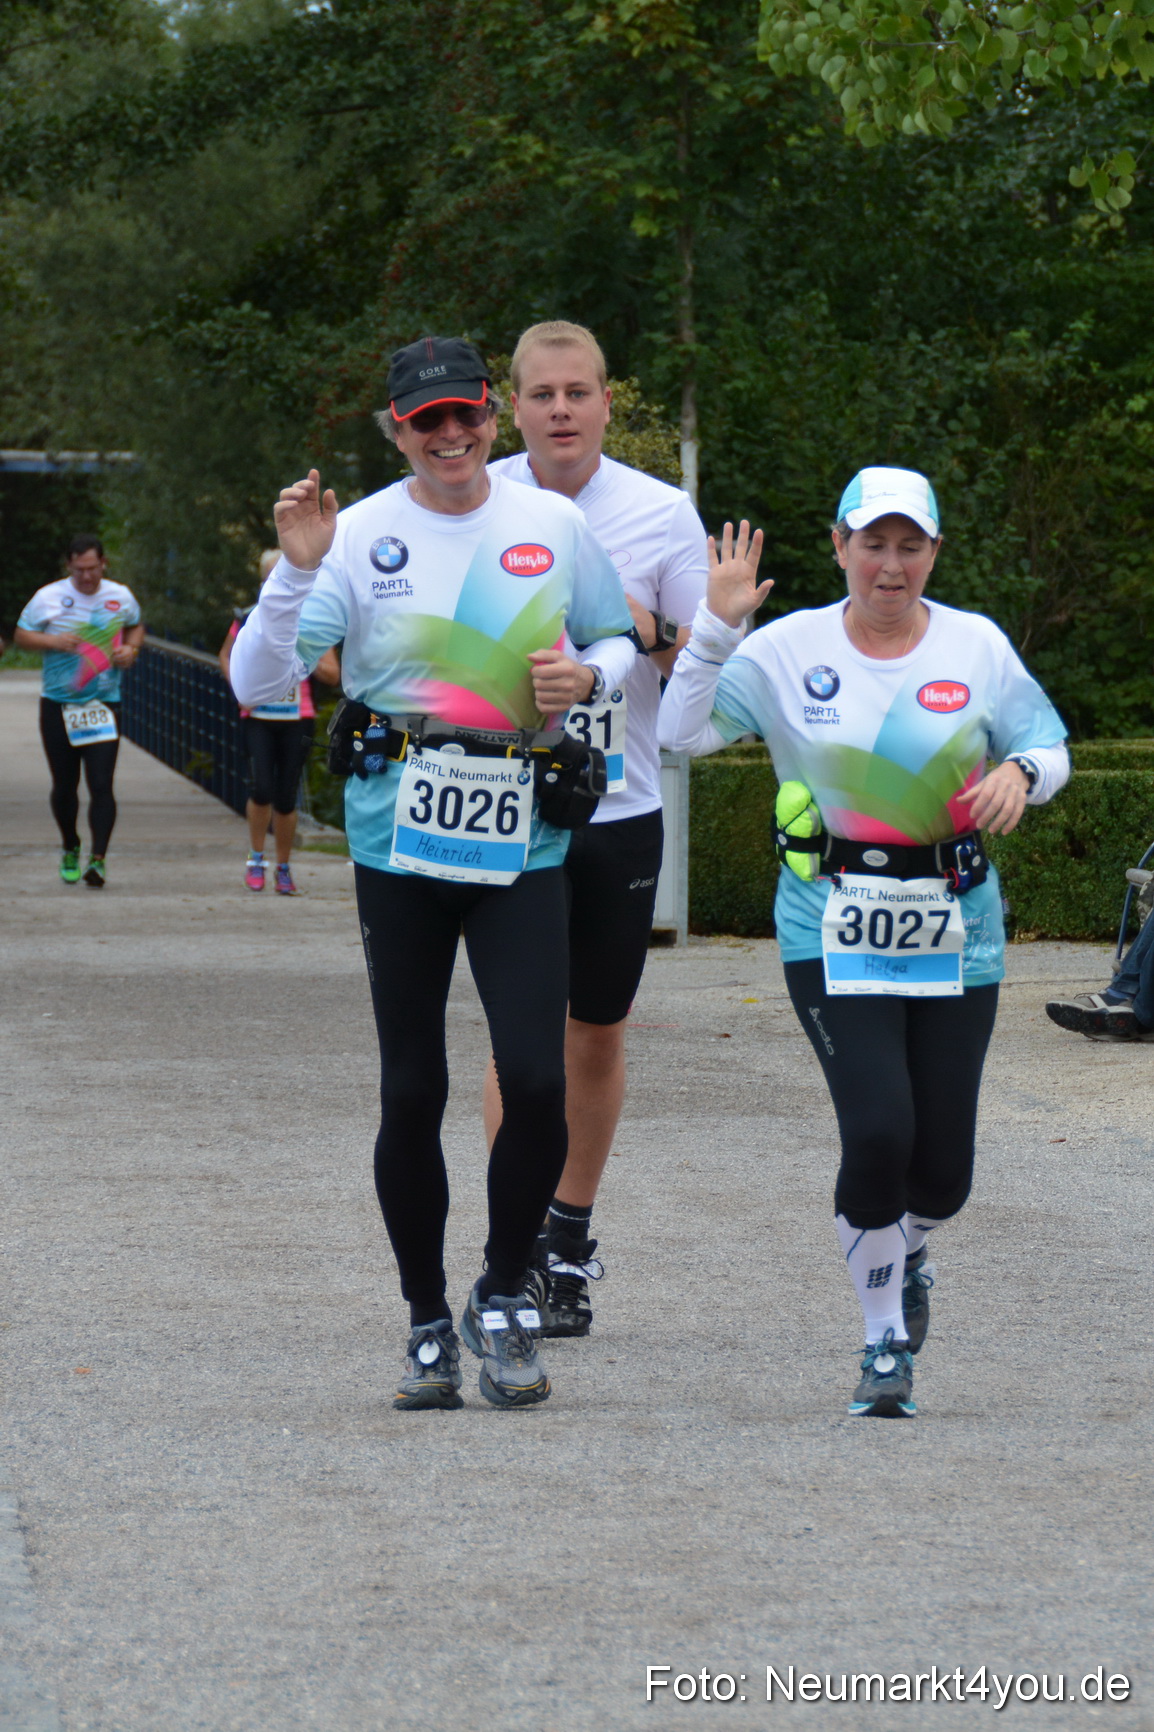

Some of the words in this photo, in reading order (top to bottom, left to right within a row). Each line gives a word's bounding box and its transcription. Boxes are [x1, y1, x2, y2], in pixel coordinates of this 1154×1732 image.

[419, 365, 447, 378] GORE
[372, 537, 405, 550] BMW
[507, 551, 549, 569] Hervis
[372, 578, 413, 592] PARTL
[373, 589, 414, 600] Neumarkt
[924, 688, 965, 705] Hervis
[69, 708, 109, 729] 2488
[804, 706, 841, 718] PARTL
[804, 716, 841, 725] Neumarkt
[454, 730, 520, 744] NATHAN
[408, 757, 446, 777] PARTL
[449, 767, 513, 784] Neumarkt
[409, 779, 520, 836] 3026
[416, 835, 482, 864] Heinrich
[833, 886, 875, 900] PARTL
[878, 889, 940, 903] Neumarkt
[837, 905, 951, 950] 3027
[864, 955, 909, 980] Helga
[866, 1278, 890, 1289] cep
